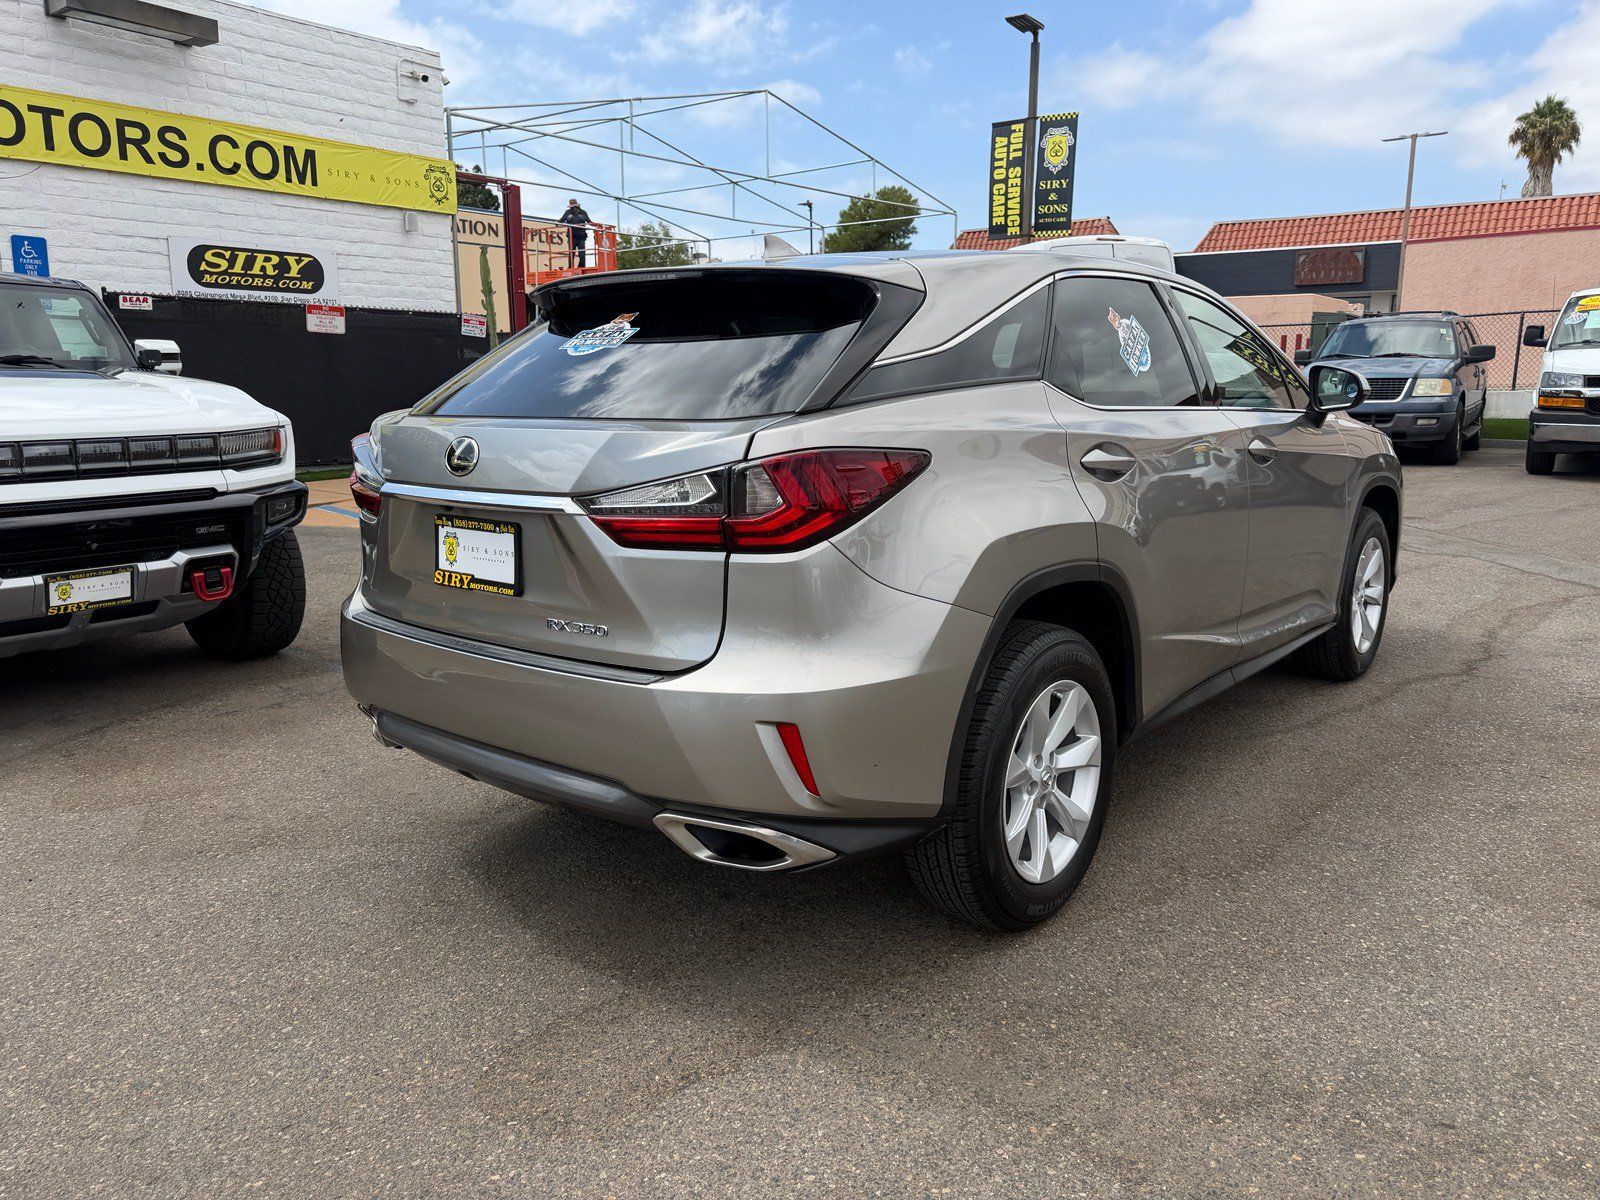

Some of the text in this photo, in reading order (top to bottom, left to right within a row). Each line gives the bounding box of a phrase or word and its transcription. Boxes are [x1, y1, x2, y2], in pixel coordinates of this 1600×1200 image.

[327, 168, 420, 189] SIRY & SONS
[992, 136, 1009, 227] AUTO CARE
[1007, 122, 1025, 236] FULL SERVICE
[1038, 178, 1070, 190] SIRY
[1048, 192, 1059, 201] &
[1037, 203, 1069, 215] SONS
[20, 257, 42, 265] PARKING
[199, 248, 314, 278] SIRY
[201, 274, 315, 290] MOTORS.COM
[195, 525, 225, 534] GMC
[463, 545, 480, 553] SIRY
[493, 549, 515, 558] SONS
[434, 569, 515, 596] SIRY MOTORS.COM
[48, 601, 90, 616] SIRY
